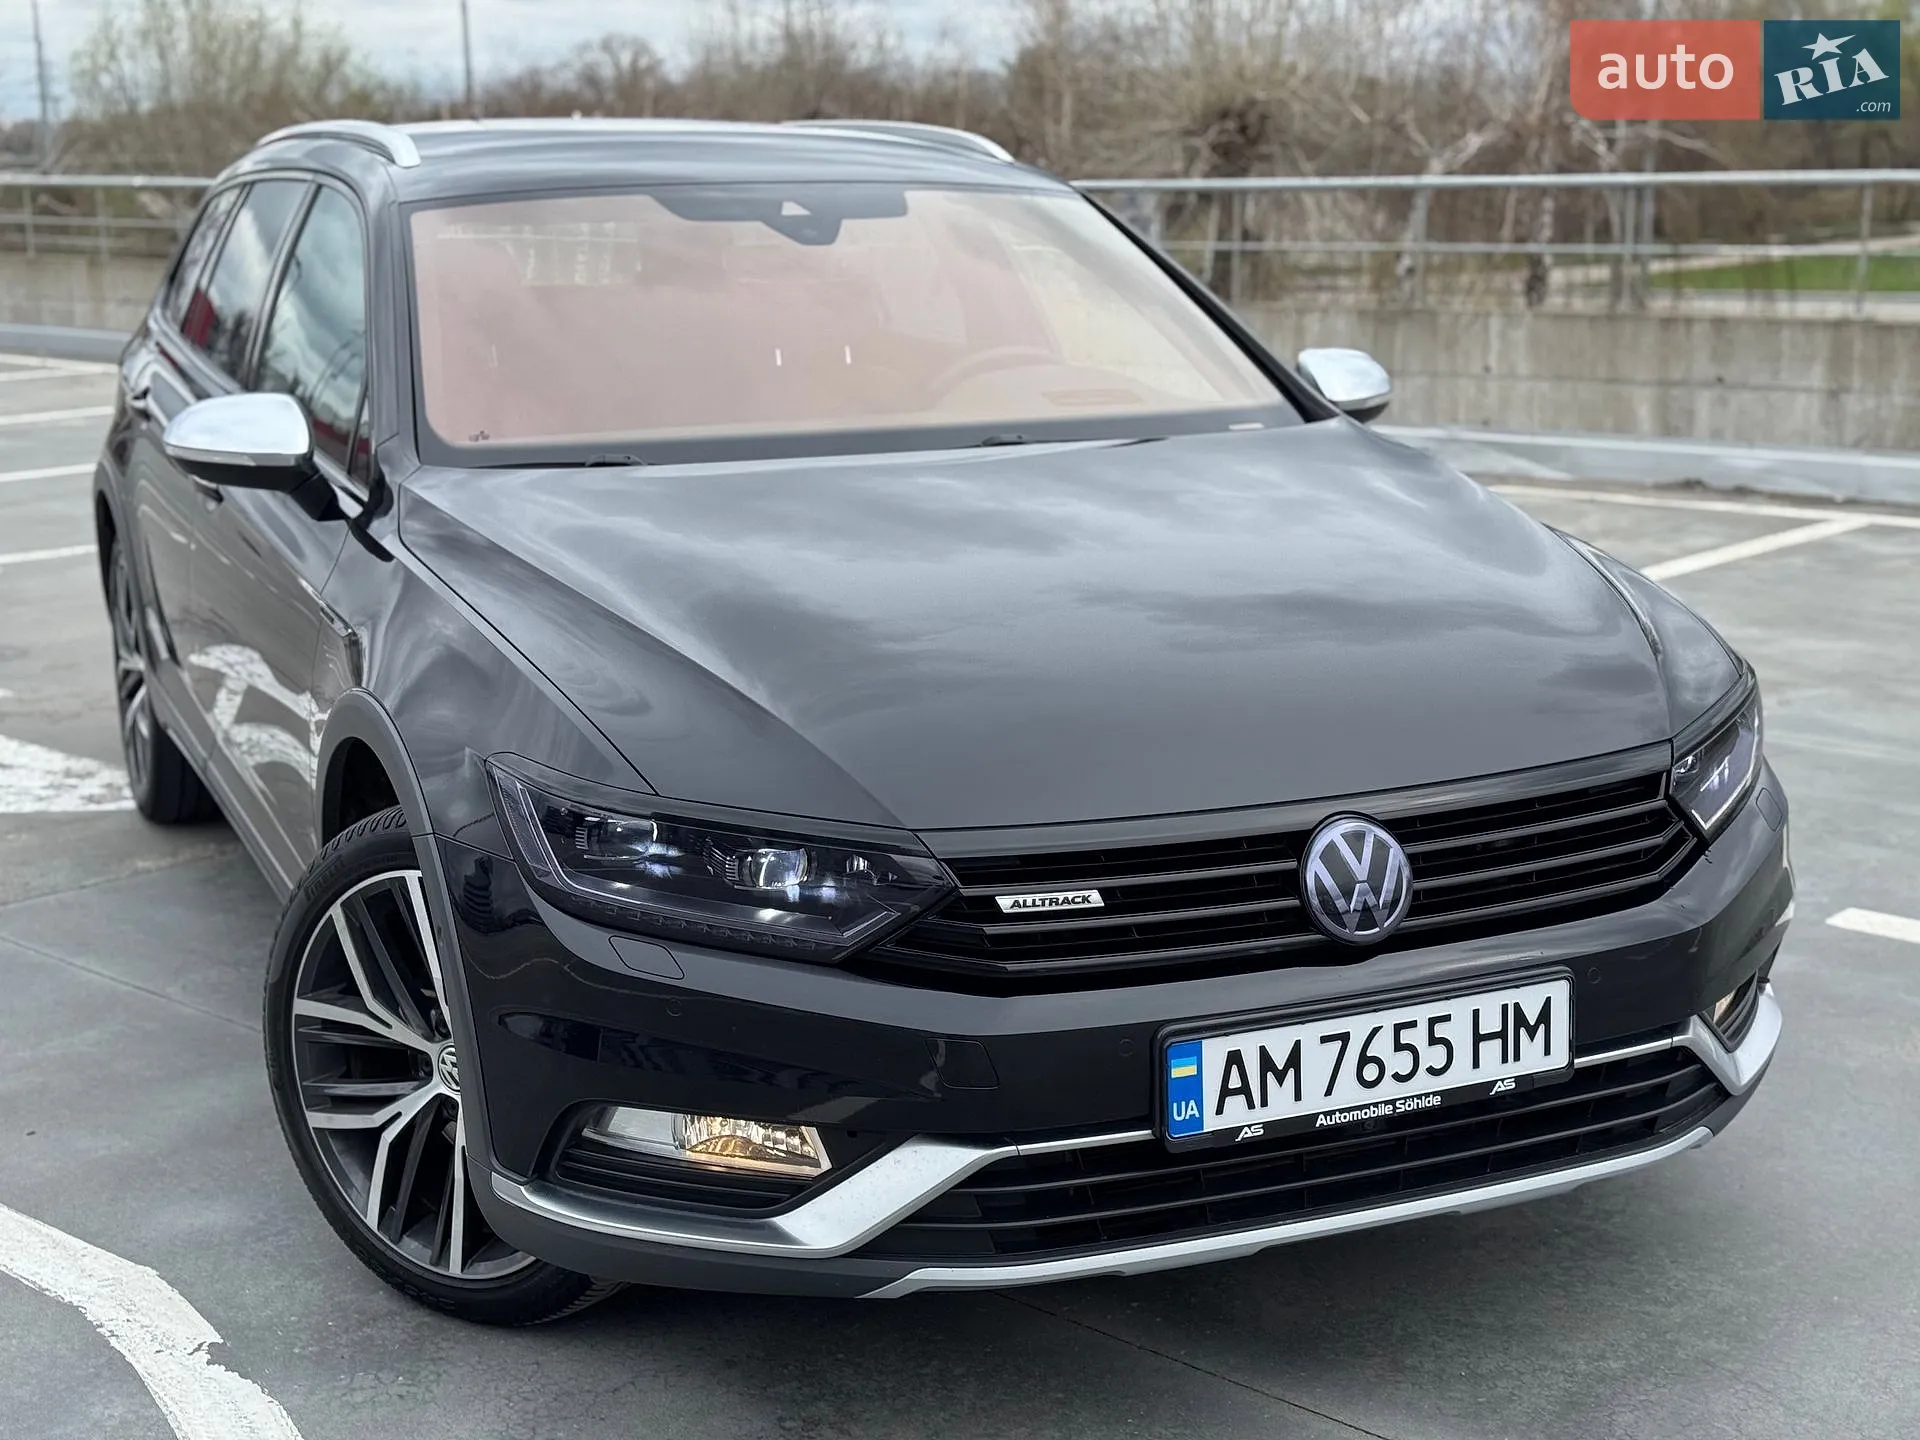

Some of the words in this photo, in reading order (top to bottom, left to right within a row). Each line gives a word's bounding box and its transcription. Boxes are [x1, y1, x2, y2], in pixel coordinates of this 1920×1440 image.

[1009, 894, 1092, 909] ALLTRACK
[1214, 1038, 1302, 1116] AM
[1319, 1013, 1455, 1097] 7655
[1471, 995, 1552, 1070] HM
[1172, 1099, 1200, 1122] UA
[1315, 1103, 1394, 1128] Automobile
[1395, 1093, 1442, 1116] Söhlde
